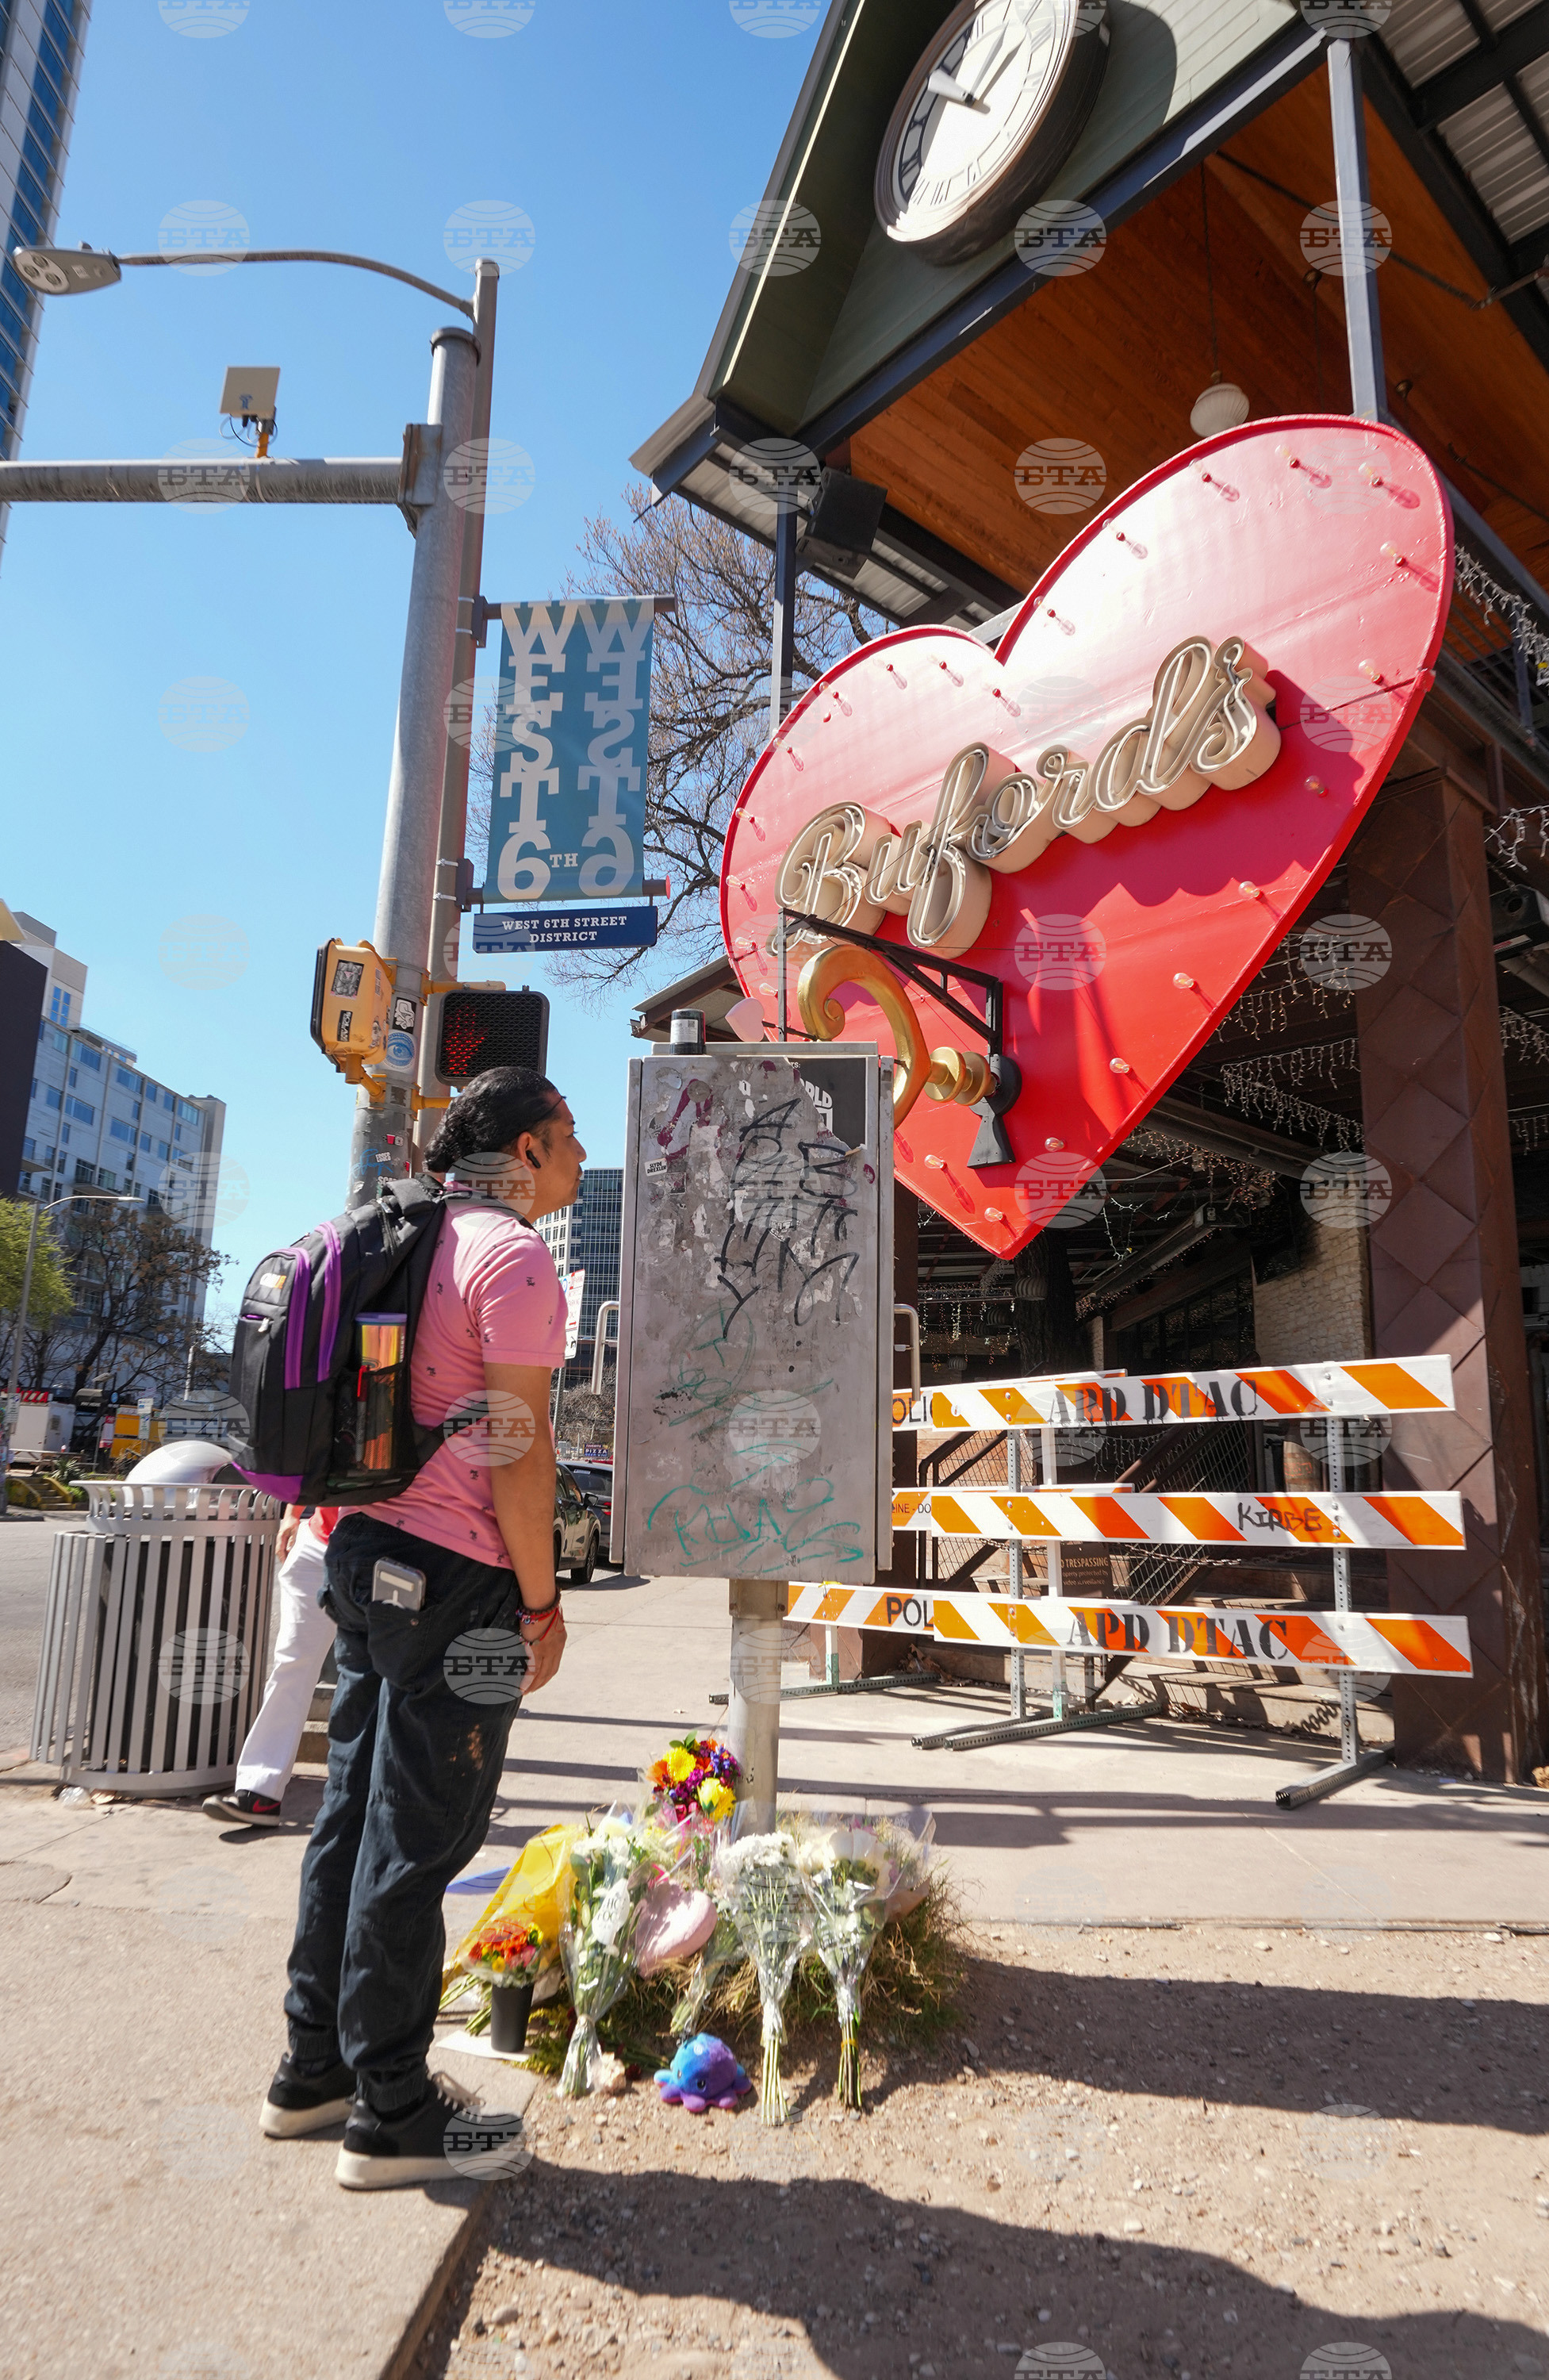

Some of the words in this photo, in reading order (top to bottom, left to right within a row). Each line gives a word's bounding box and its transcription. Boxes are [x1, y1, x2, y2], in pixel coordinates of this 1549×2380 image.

[501, 601, 579, 834] WEST
[501, 919, 540, 931] WEST
[543, 918, 569, 929] 6TH
[573, 916, 627, 927] STREET
[529, 931, 598, 943] DISTRICT
[1141, 1379, 1258, 1421] DTAC
[1065, 1557, 1109, 1568] TRESPASSING
[1066, 1611, 1150, 1651] APD
[1166, 1615, 1288, 1660] DTAC
